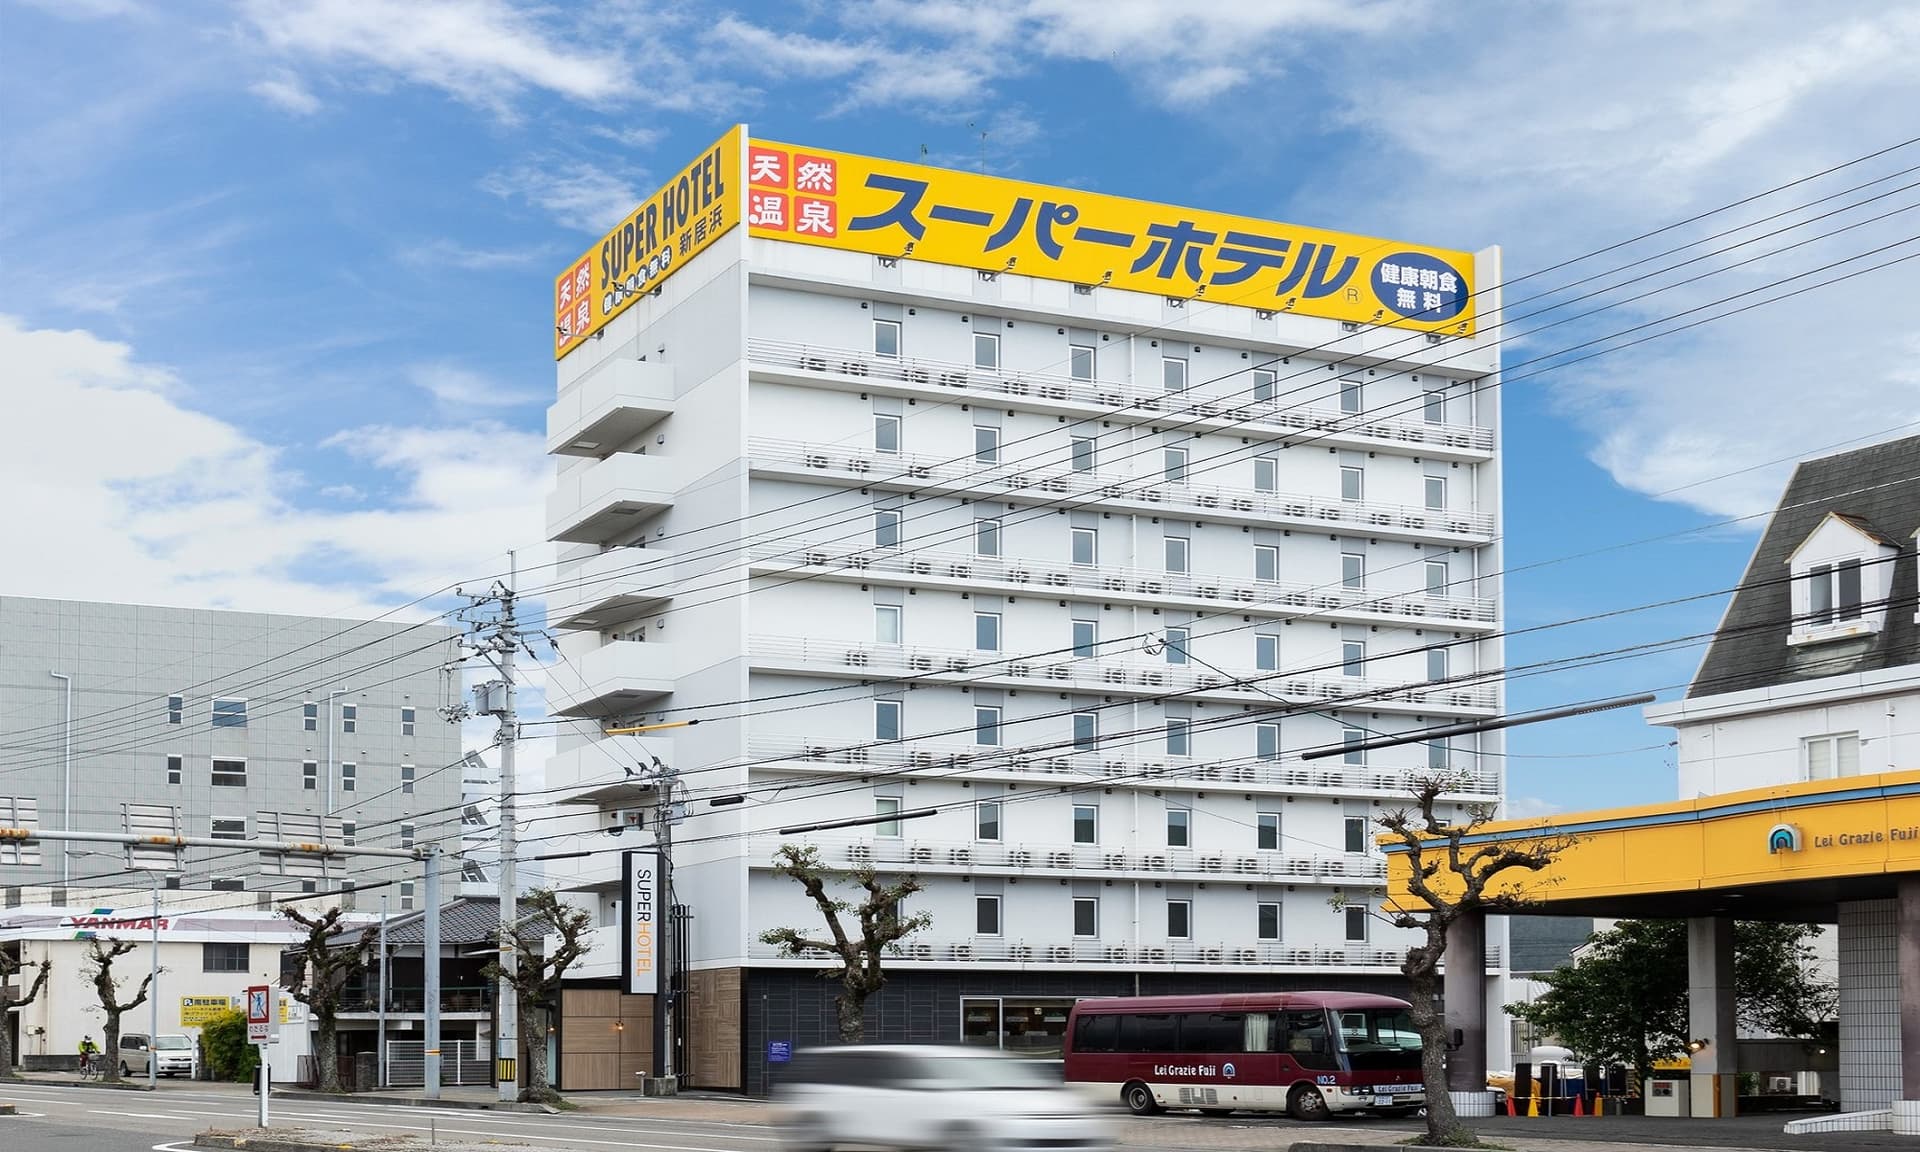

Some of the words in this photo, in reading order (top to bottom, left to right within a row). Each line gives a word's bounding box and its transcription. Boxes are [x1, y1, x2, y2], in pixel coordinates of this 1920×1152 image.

[750, 155, 833, 192] 天然
[601, 202, 658, 290] SUPER
[663, 147, 725, 241] HOTEL
[679, 203, 723, 257] 新居浜
[749, 195, 834, 233] 温泉
[847, 173, 1360, 299] スーパーホテル
[559, 262, 590, 310] 天然
[1380, 262, 1458, 294] 健康朝食
[1396, 287, 1442, 313] 無料
[559, 300, 590, 347] 温泉
[1814, 834, 1833, 848] Lei
[1839, 831, 1884, 846] Grazie
[1890, 826, 1919, 841] Fuji
[70, 916, 169, 931] YANMAR
[1154, 1064, 1167, 1076] Lei
[1168, 1064, 1196, 1076] Grazie
[1198, 1064, 1217, 1077] Fuji
[1316, 1075, 1336, 1085] NO.2
